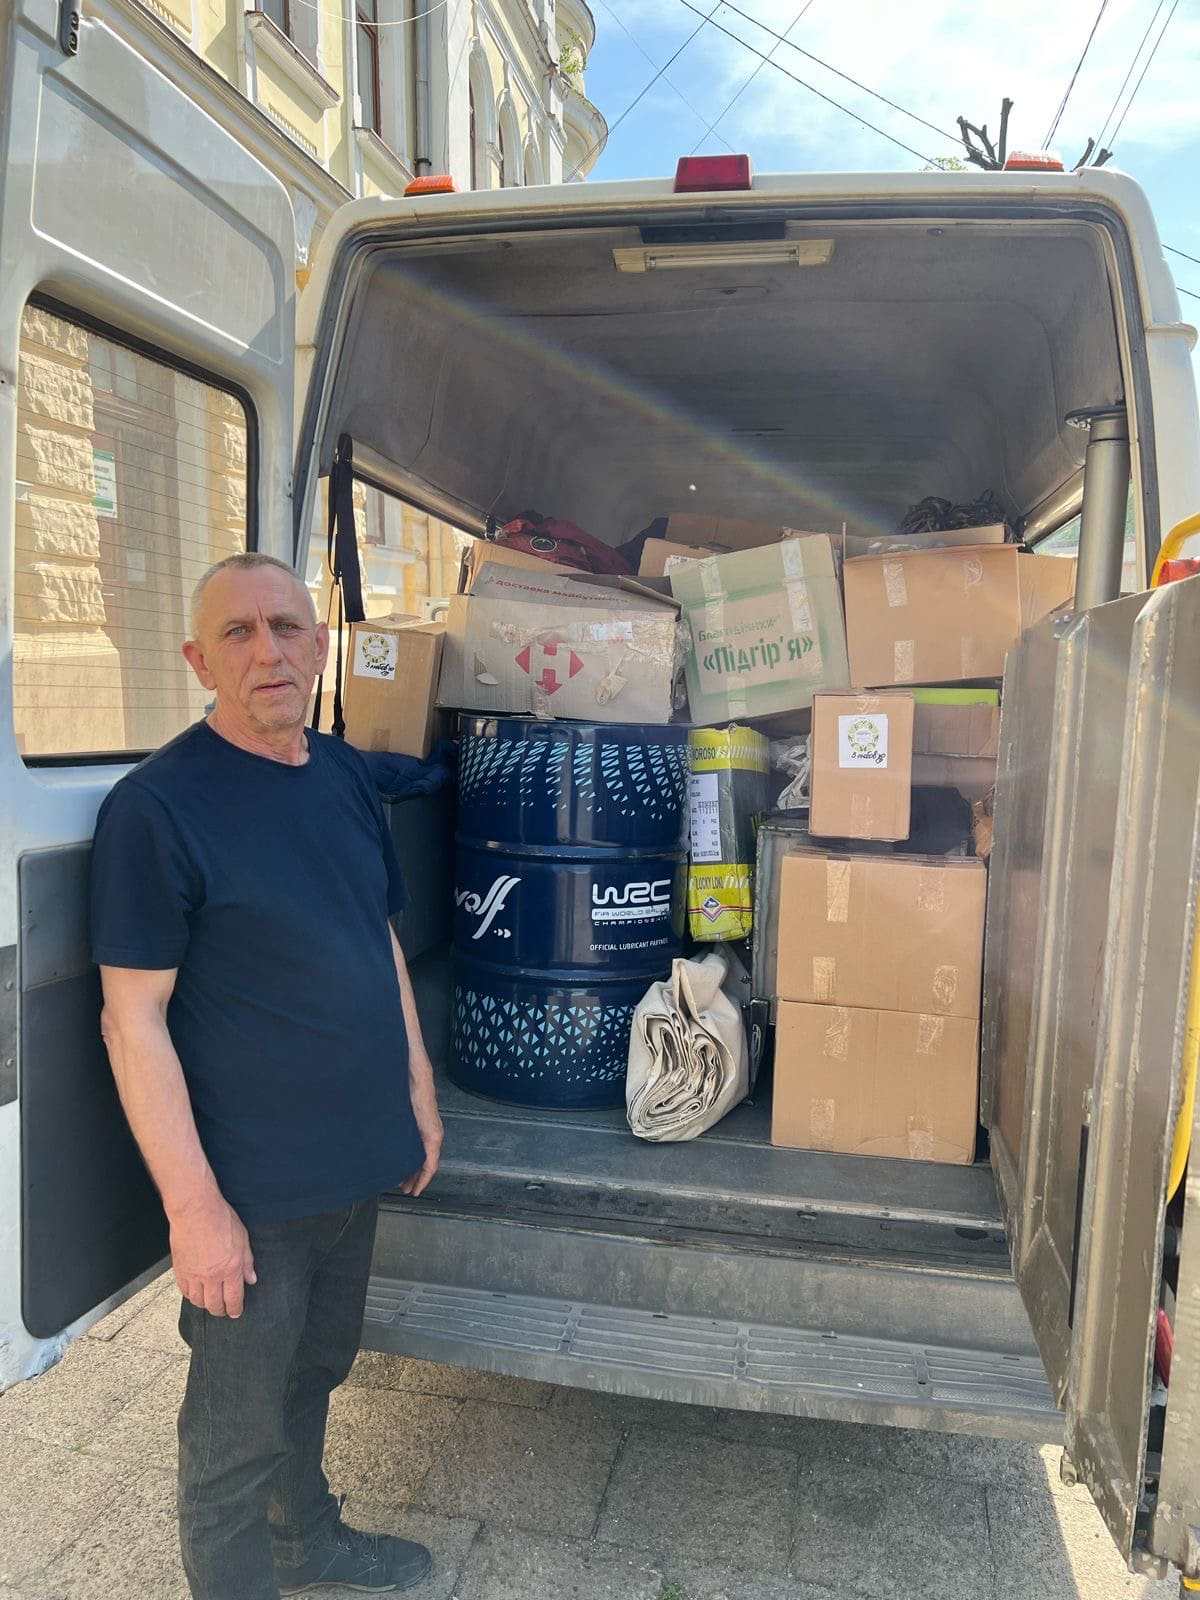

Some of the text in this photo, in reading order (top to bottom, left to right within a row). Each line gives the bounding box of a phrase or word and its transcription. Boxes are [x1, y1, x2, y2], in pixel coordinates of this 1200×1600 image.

[691, 746, 716, 761] OROSO
[592, 879, 671, 905] WRC
[619, 941, 649, 950] LUBRICANT
